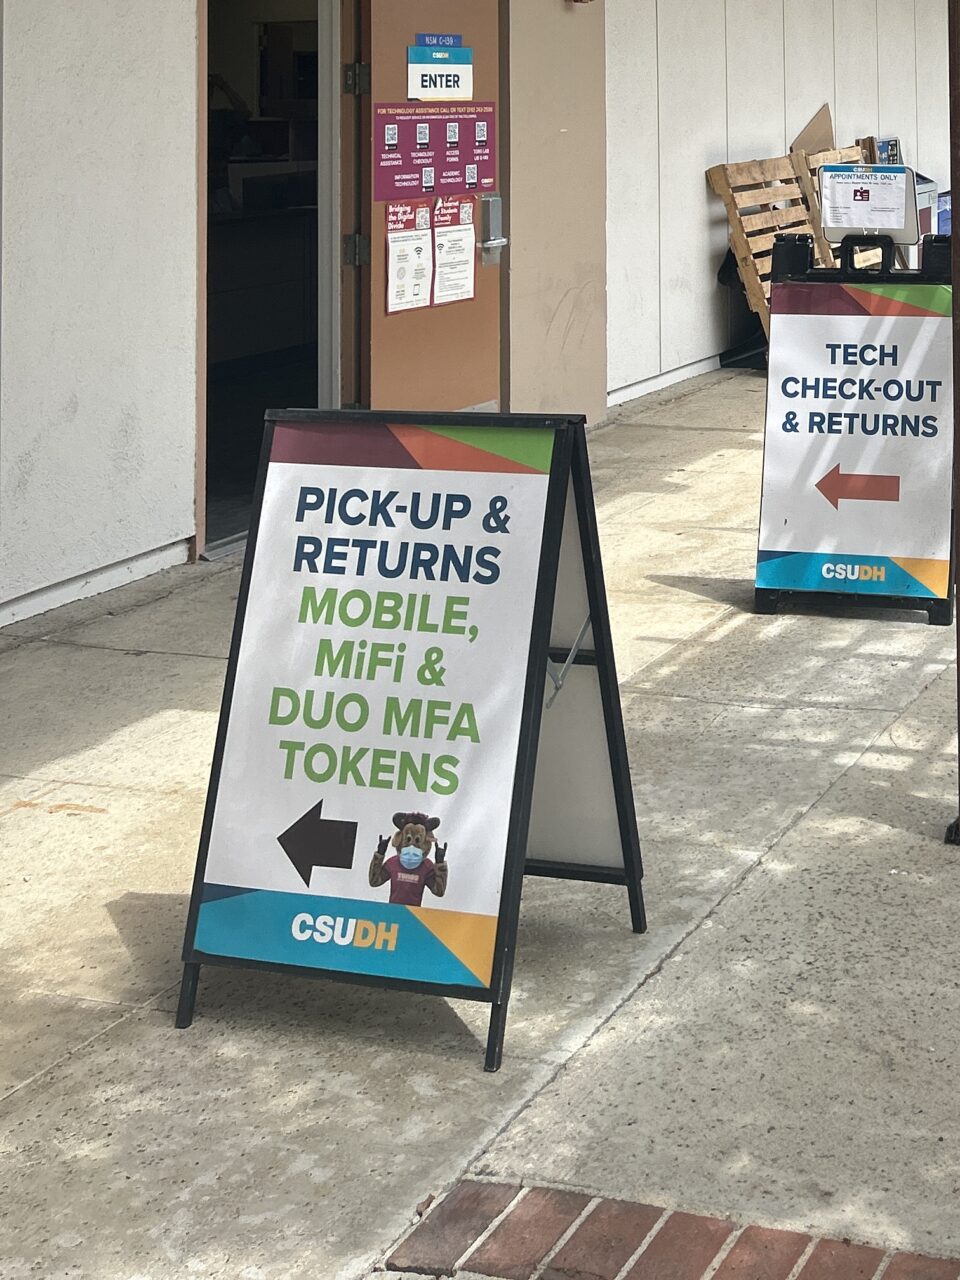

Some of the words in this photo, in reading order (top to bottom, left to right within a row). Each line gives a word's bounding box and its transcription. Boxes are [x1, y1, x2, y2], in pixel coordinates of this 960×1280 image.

[421, 73, 460, 89] ENTER
[829, 173, 878, 181] APPOINTMENTS
[388, 204, 412, 214] Bridging
[388, 213, 397, 221] the
[397, 211, 415, 222] Digital
[388, 221, 405, 230] Divide
[825, 343, 898, 367] TECH
[781, 376, 943, 403] CHECK-OUT
[781, 411, 800, 434] &
[808, 411, 939, 438] RETURNS
[295, 486, 472, 531] PICK-UP
[482, 495, 511, 534] &
[292, 535, 502, 585] RETURNS
[821, 563, 886, 581] CSUDH
[299, 586, 477, 643] MOBILE,
[315, 639, 407, 684] MiFi
[417, 648, 445, 685] &
[269, 688, 369, 732] DUO
[383, 698, 480, 742] MFA
[280, 741, 459, 796] TOKENS
[291, 912, 399, 951] CSUDH
